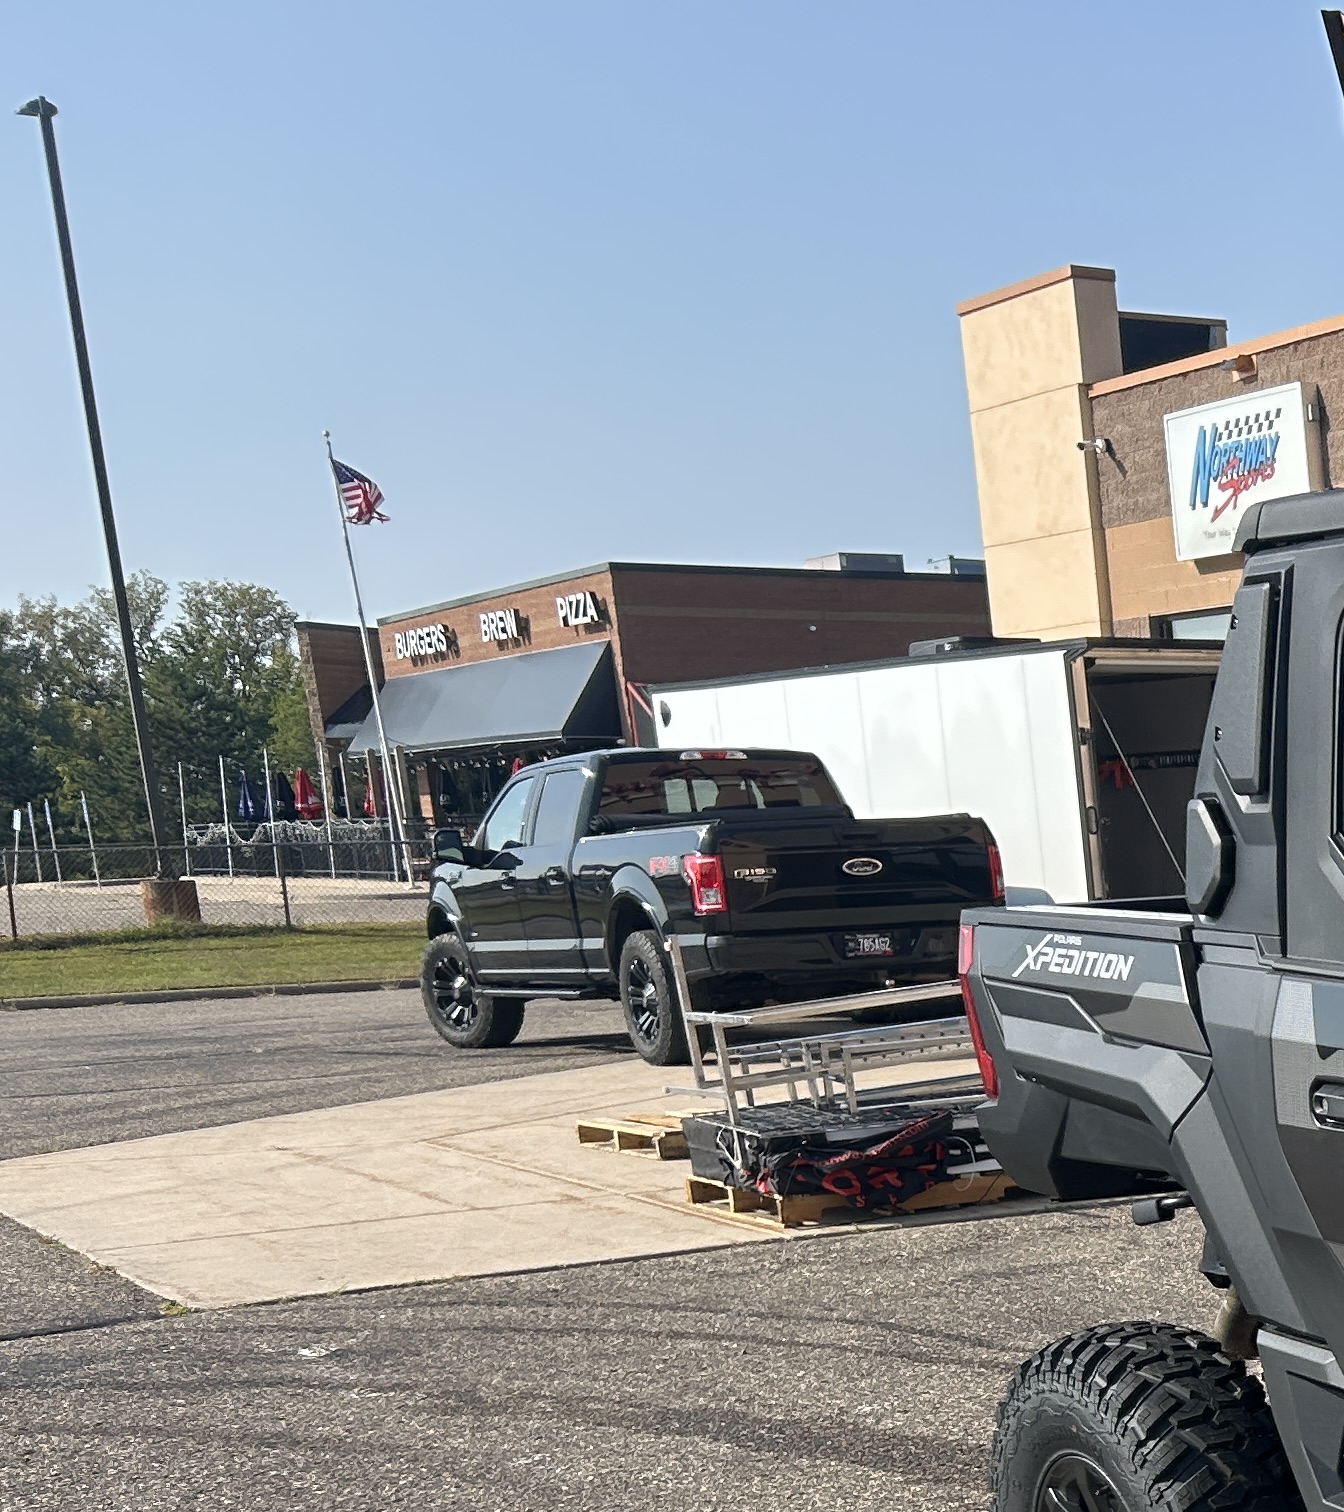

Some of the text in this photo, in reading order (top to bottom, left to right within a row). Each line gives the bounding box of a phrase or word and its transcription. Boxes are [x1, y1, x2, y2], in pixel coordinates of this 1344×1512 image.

[1189, 422, 1280, 510] NORTHWAY
[394, 591, 599, 659] BURGERS BREW PIZZA
[1011, 934, 1135, 981] XPEDITION
